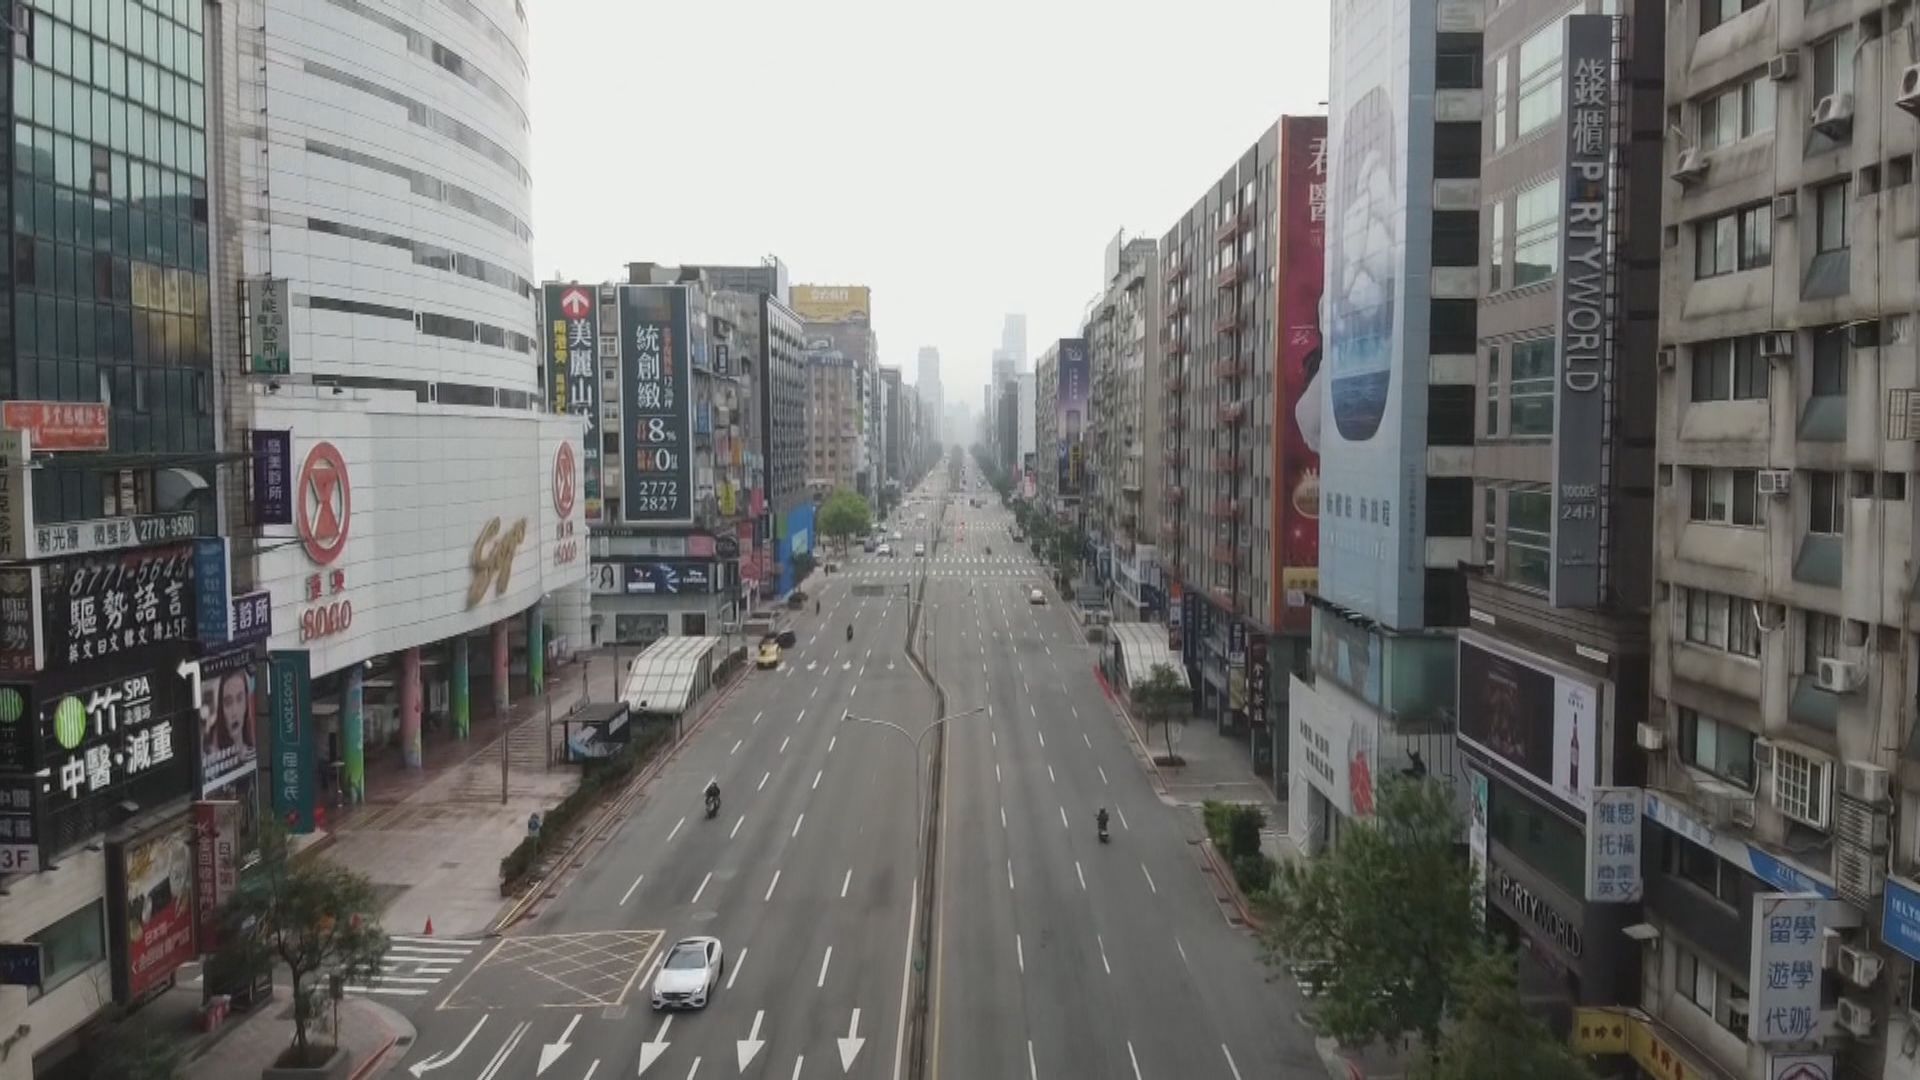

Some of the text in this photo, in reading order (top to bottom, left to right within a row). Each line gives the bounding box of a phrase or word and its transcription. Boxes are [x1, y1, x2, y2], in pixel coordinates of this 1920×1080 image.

[1573, 58, 1607, 155] 錢櫃
[1566, 162, 1605, 392] PRTYWORLD
[639, 481, 677, 496] 2772
[639, 497, 677, 511] 2827
[1561, 503, 1596, 520] 24H
[140, 516, 194, 541] 2778-9580
[70, 555, 188, 596] 8771-5643
[69, 580, 183, 639] 驅勢語言
[69, 641, 93, 664] 英文
[97, 634, 120, 655] 日文
[123, 676, 150, 700] SPA
[283, 671, 294, 733] watsons
[1599, 802, 1634, 824] 雅思
[1598, 832, 1635, 855] 托福
[2, 849, 30, 869] 3F
[1769, 916, 1816, 944] 留學
[1767, 960, 1814, 989] 遊學
[1766, 1006, 1812, 1036] 代辦
